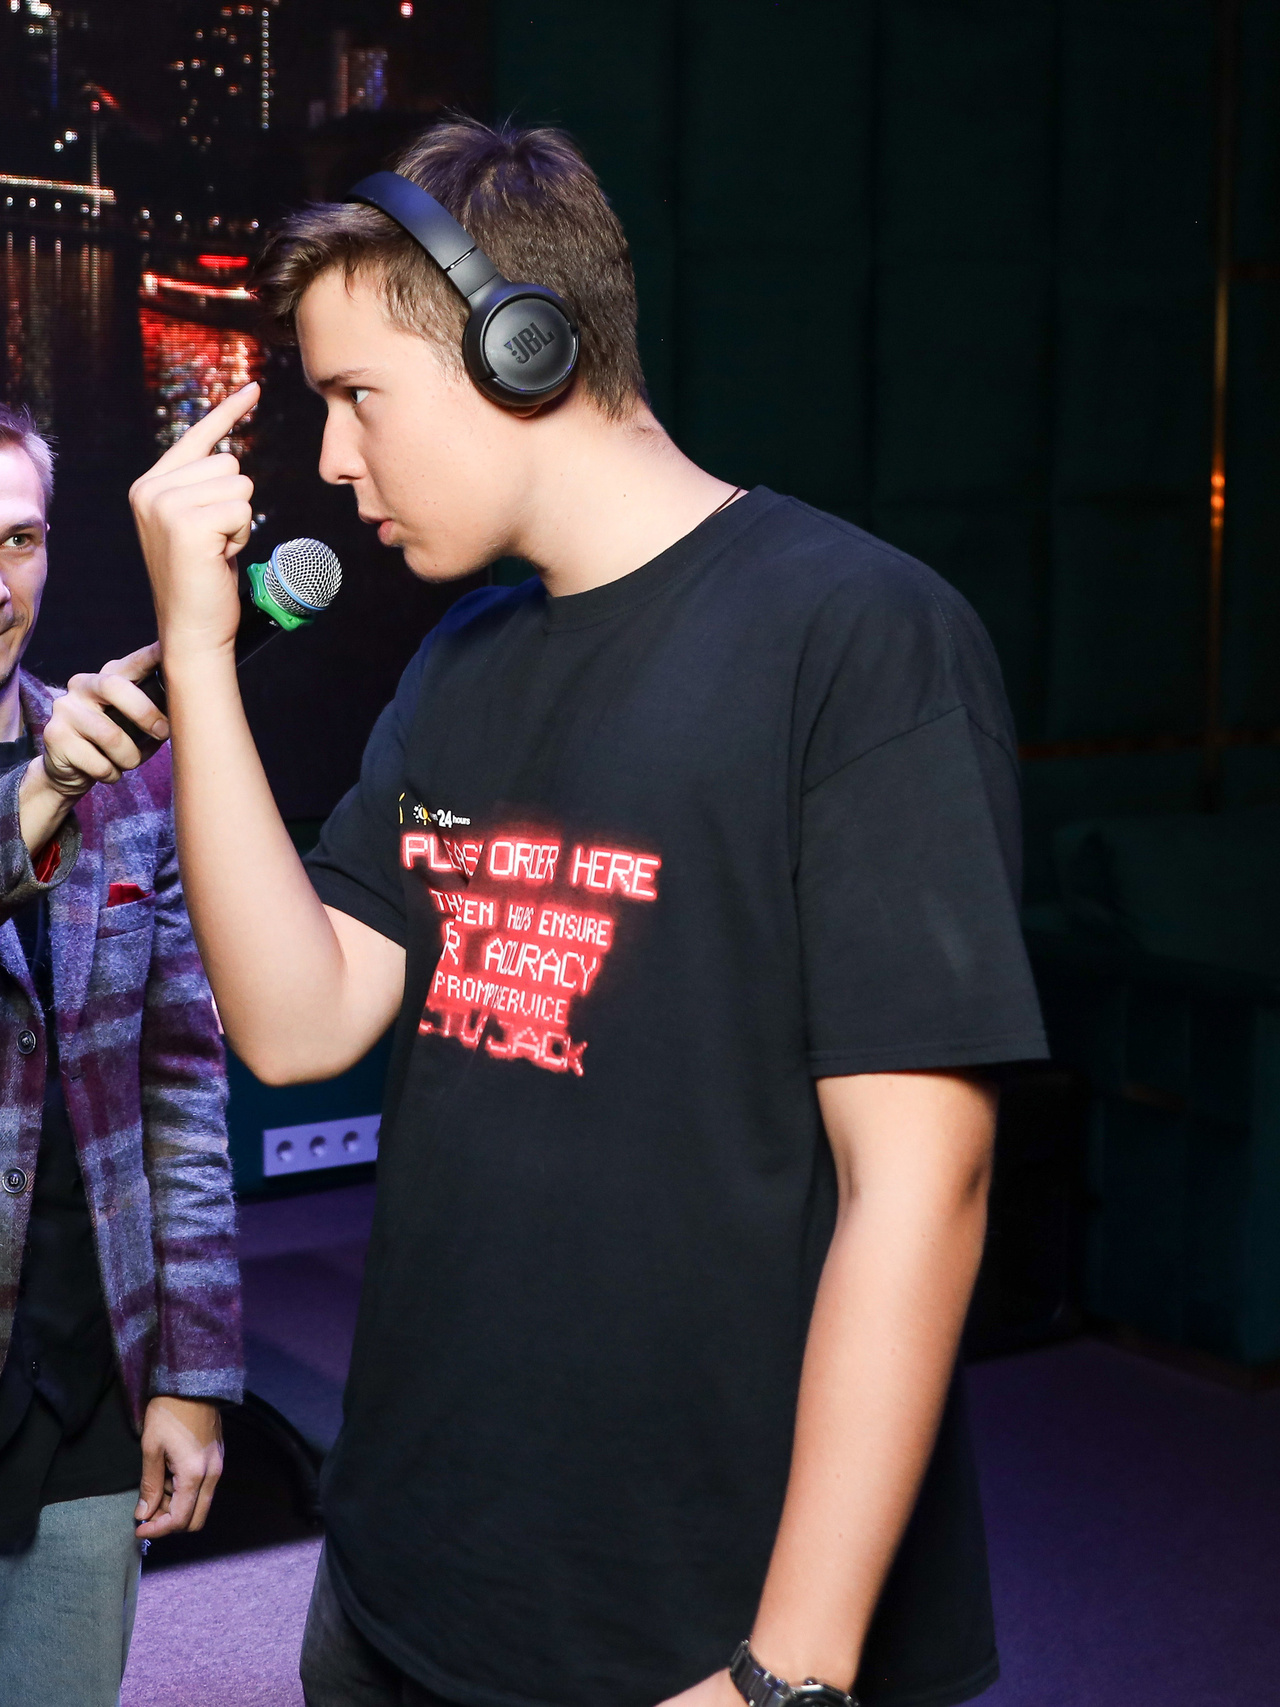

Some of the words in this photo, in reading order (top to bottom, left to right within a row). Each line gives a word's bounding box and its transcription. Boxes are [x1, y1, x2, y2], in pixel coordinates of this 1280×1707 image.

[510, 321, 556, 364] JBL
[436, 808, 453, 828] 24
[452, 814, 471, 826] hours
[572, 848, 659, 897] HERE
[538, 910, 610, 946] ENSURE
[487, 1020, 588, 1077] JACK
